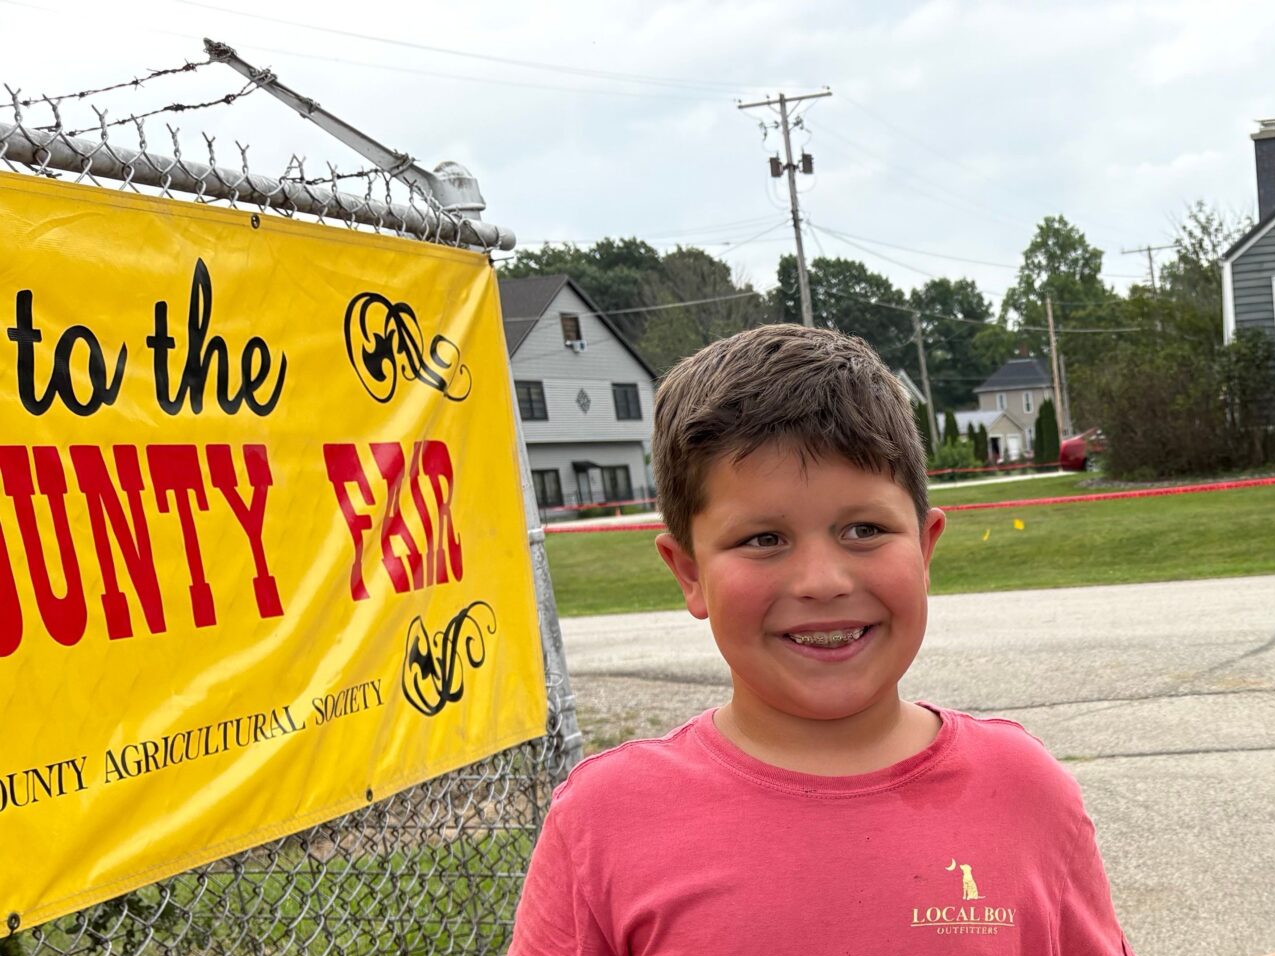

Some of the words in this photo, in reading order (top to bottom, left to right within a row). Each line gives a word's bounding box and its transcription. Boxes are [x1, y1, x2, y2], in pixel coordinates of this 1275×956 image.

[7, 289, 128, 417] to
[146, 257, 288, 417] the
[0, 444, 284, 658] UNTY
[323, 440, 463, 601] FAIR
[104, 706, 306, 783] AGRICULTURAL
[312, 679, 384, 726] SOCIETY
[912, 906, 980, 923] LOCAL
[984, 908, 1016, 923] BOY
[937, 926, 998, 935] OUTFITTERS
